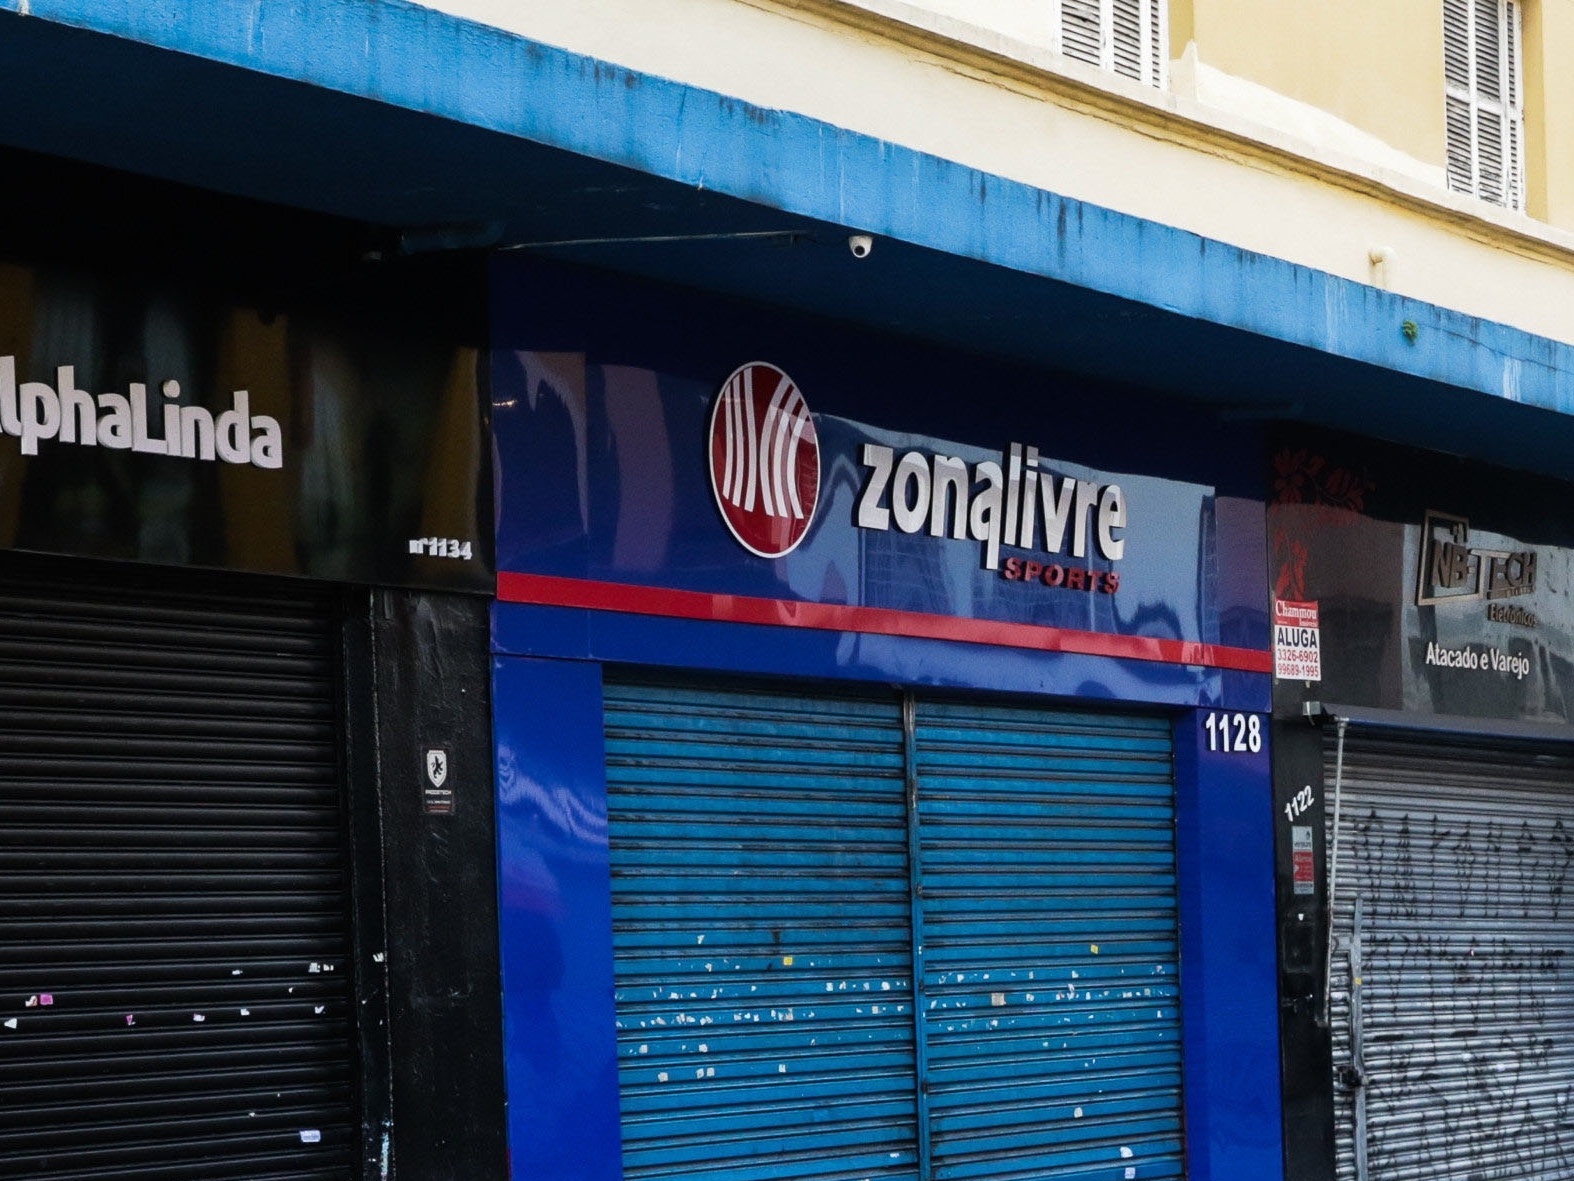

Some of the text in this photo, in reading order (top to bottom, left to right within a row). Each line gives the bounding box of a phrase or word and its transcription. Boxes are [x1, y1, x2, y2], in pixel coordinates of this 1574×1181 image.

[0, 355, 283, 469] lphaLinda
[1003, 556, 1121, 595] SPORTS
[1277, 627, 1318, 649] ALUGA
[1277, 649, 1319, 663] 3326-6902
[1426, 641, 1530, 680] Atacado e Varejo
[1205, 712, 1262, 753] 1128
[1284, 785, 1315, 822] 1122
